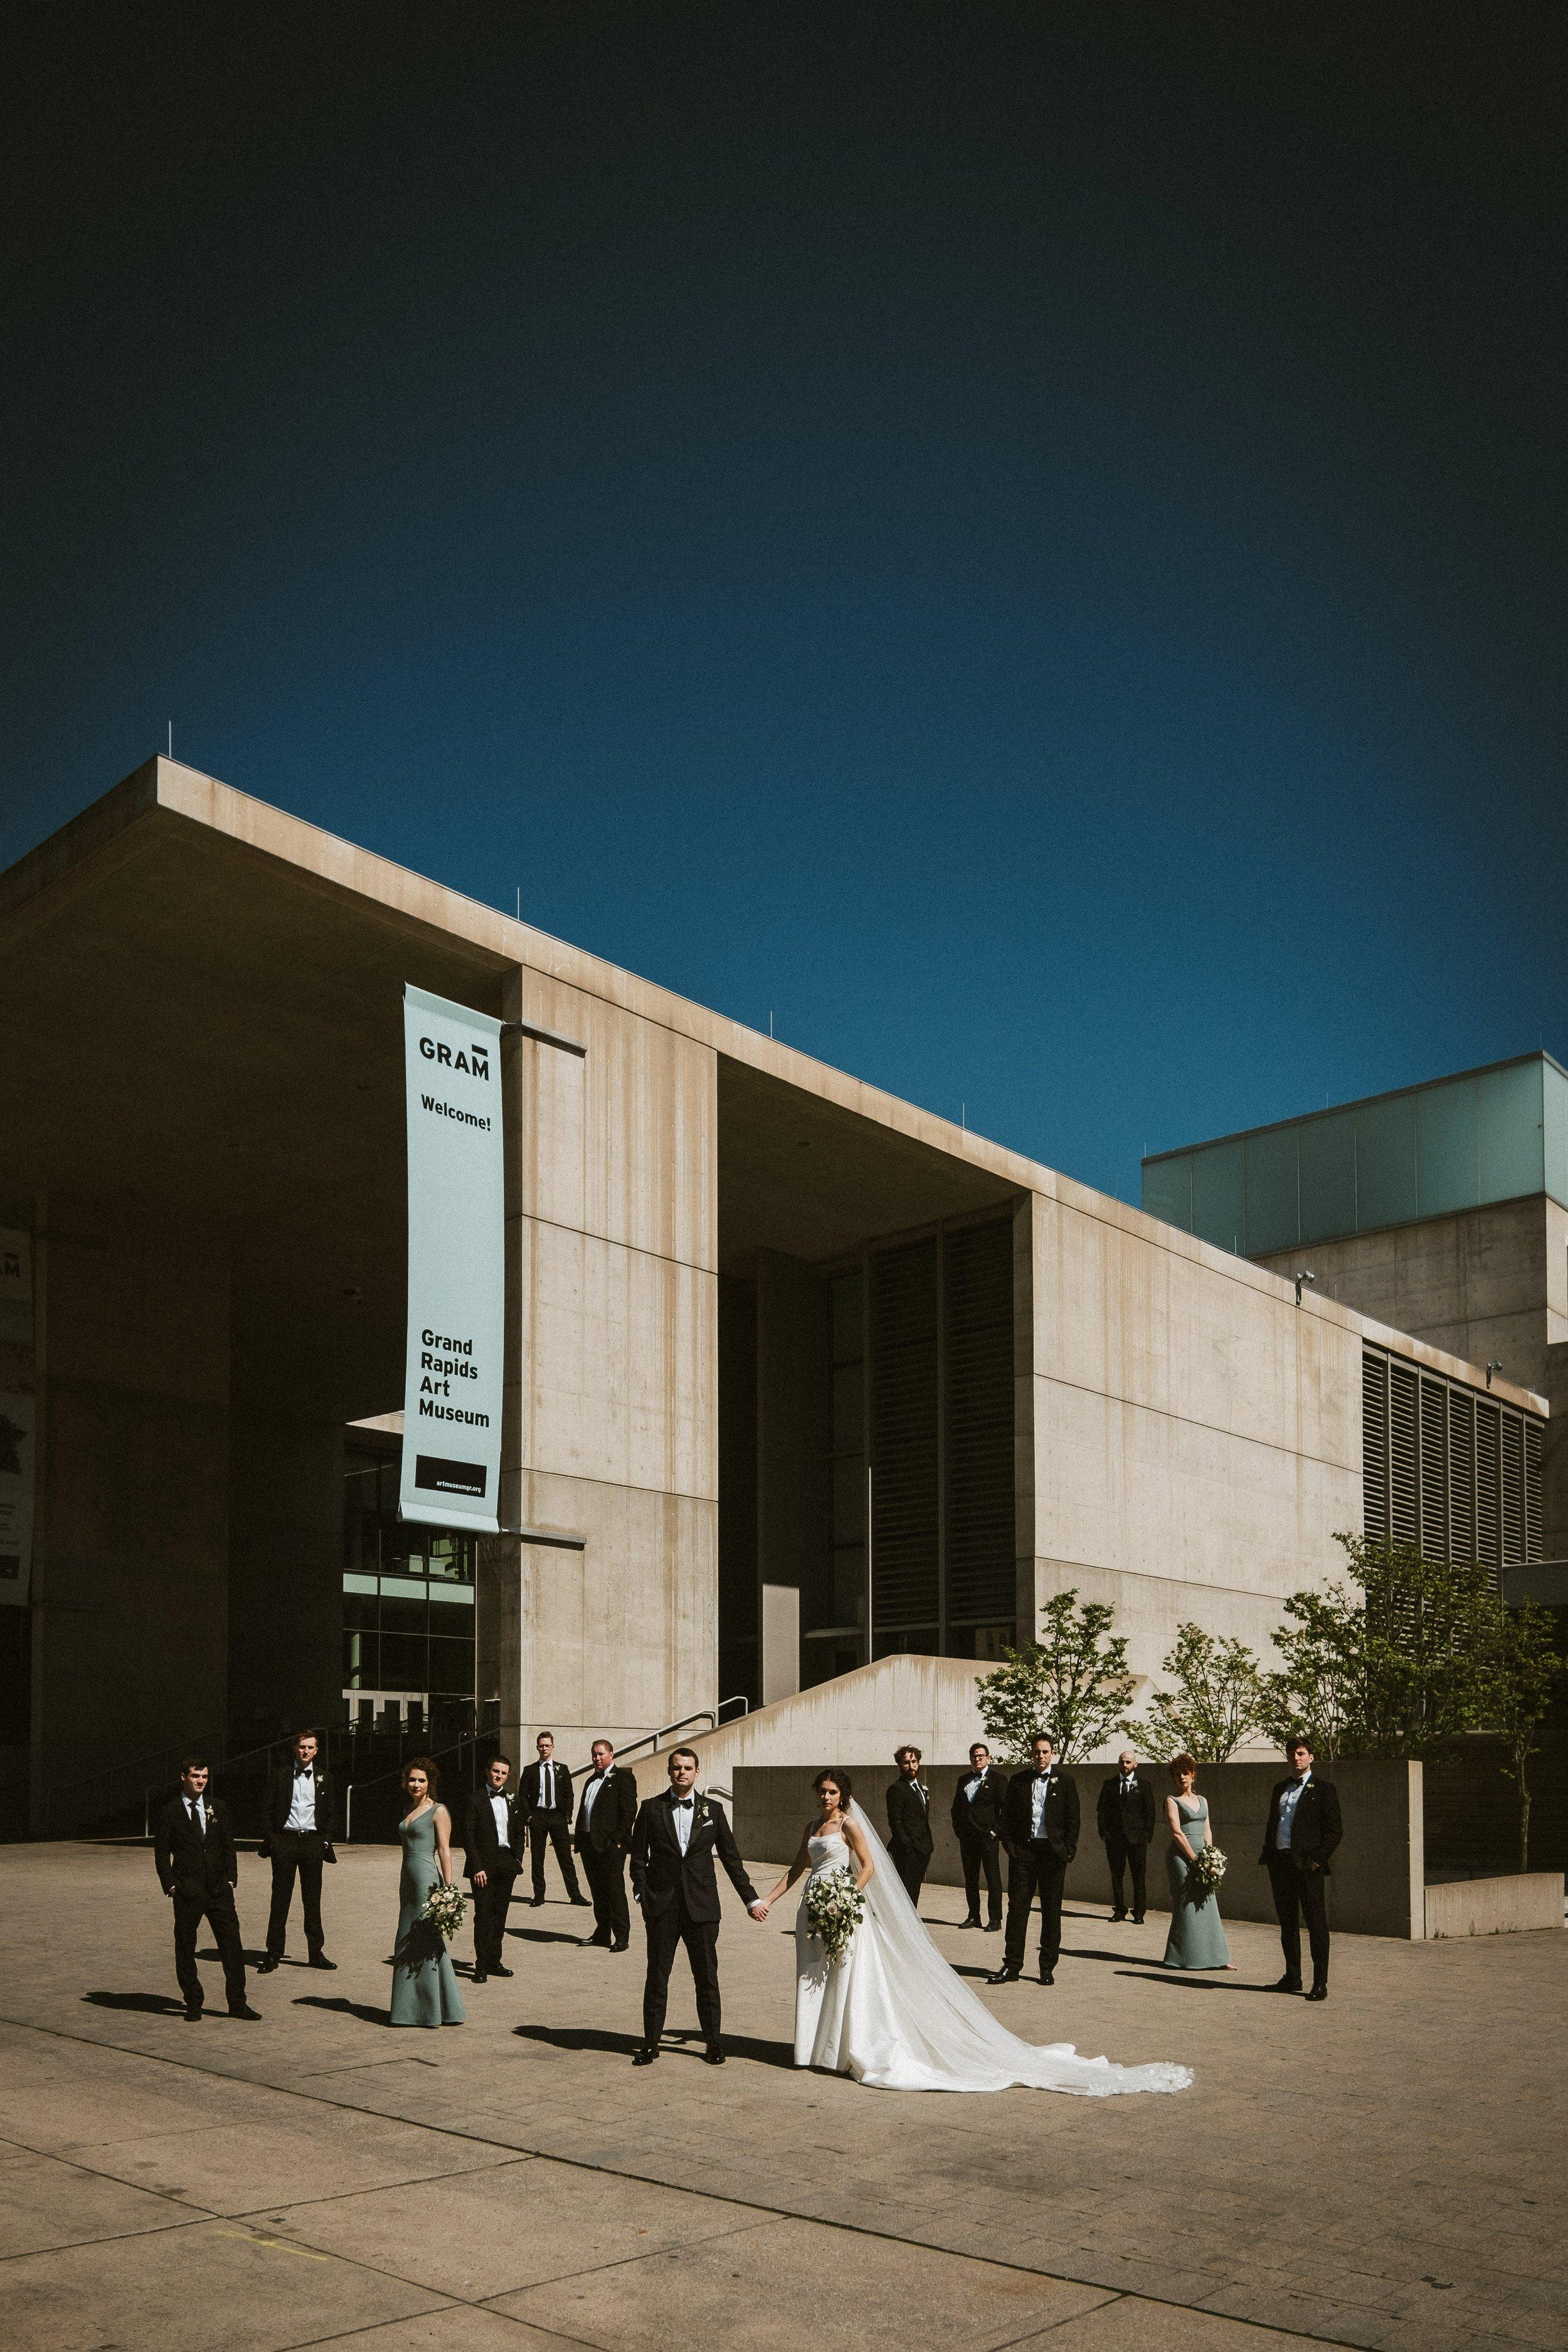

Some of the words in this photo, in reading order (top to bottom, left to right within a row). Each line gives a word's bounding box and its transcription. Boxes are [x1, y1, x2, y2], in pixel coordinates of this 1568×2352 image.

[419, 1037, 489, 1081] GRAM
[421, 1093, 491, 1131] Welcome!
[421, 1328, 473, 1356] Grand
[421, 1351, 478, 1380] Rapids
[420, 1375, 450, 1397] Art
[419, 1398, 490, 1428] Museum
[437, 1480, 481, 1493] artmuseumgr.org
